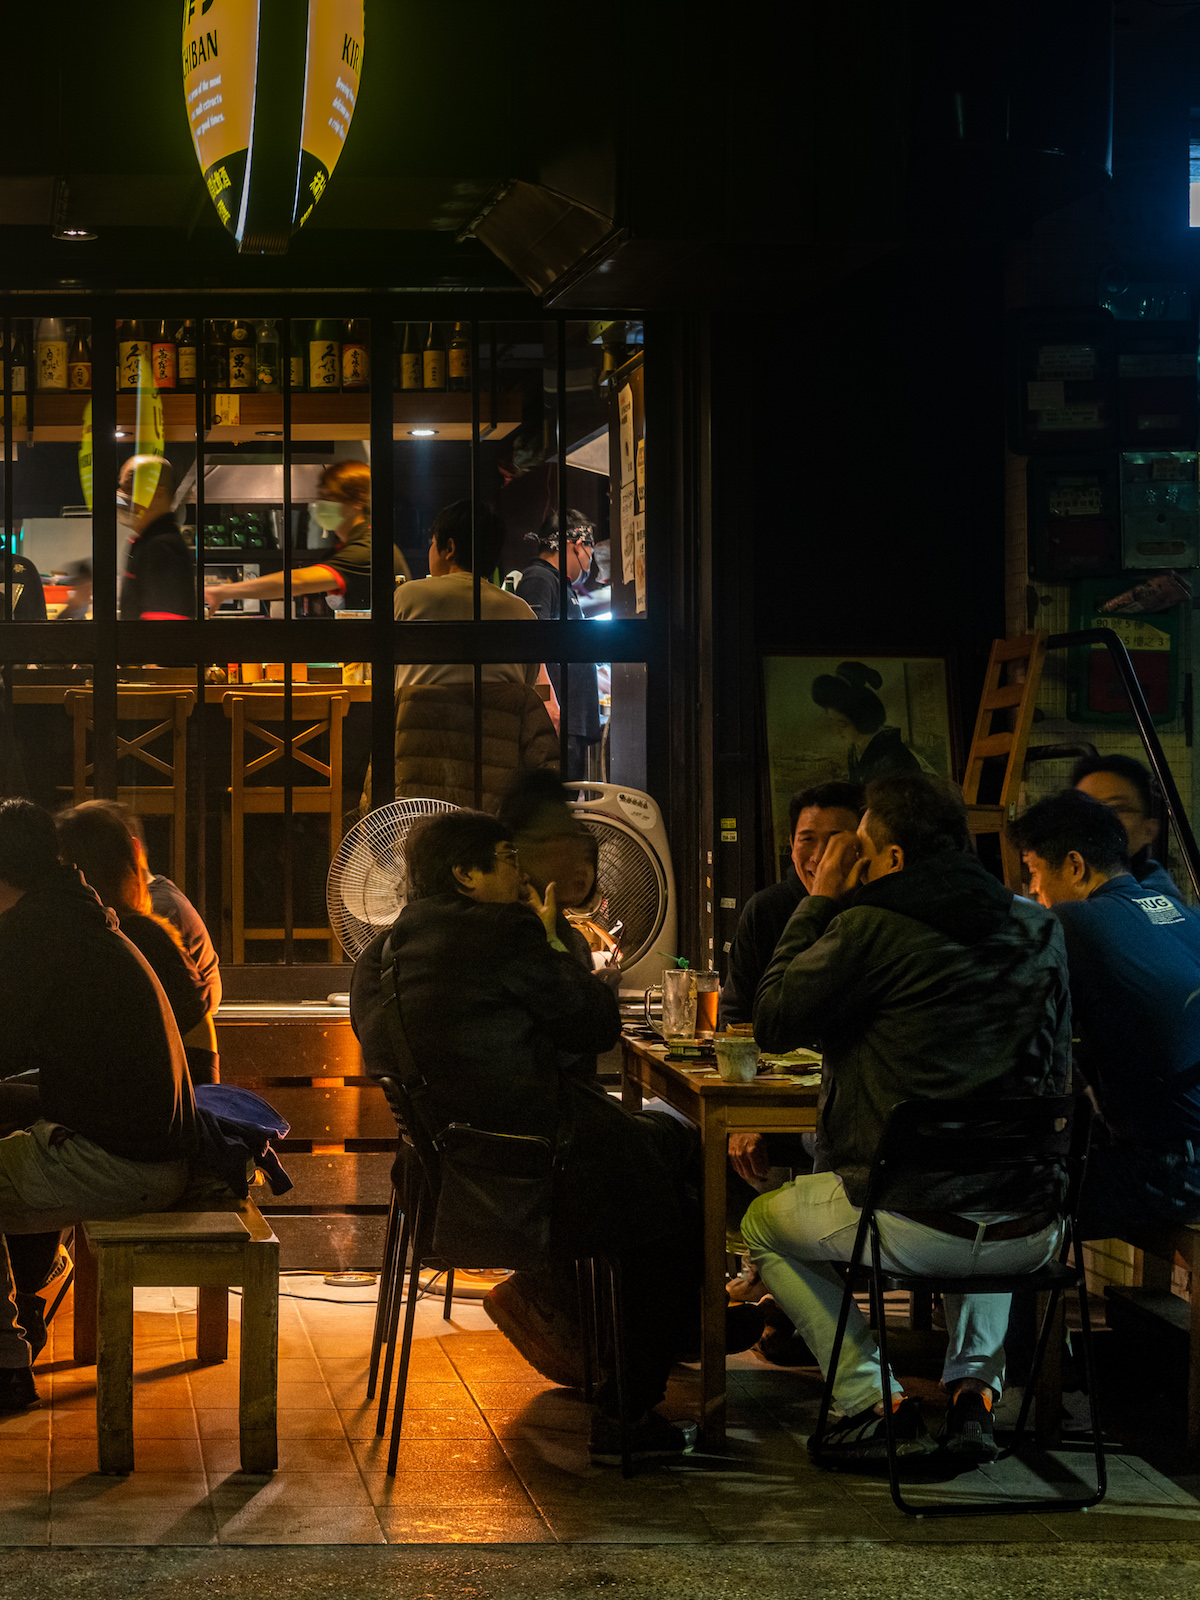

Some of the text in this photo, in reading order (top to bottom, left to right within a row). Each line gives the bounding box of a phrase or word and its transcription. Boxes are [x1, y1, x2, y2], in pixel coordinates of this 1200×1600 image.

[233, 353, 245, 380] 男山
[318, 343, 336, 384] 久保田
